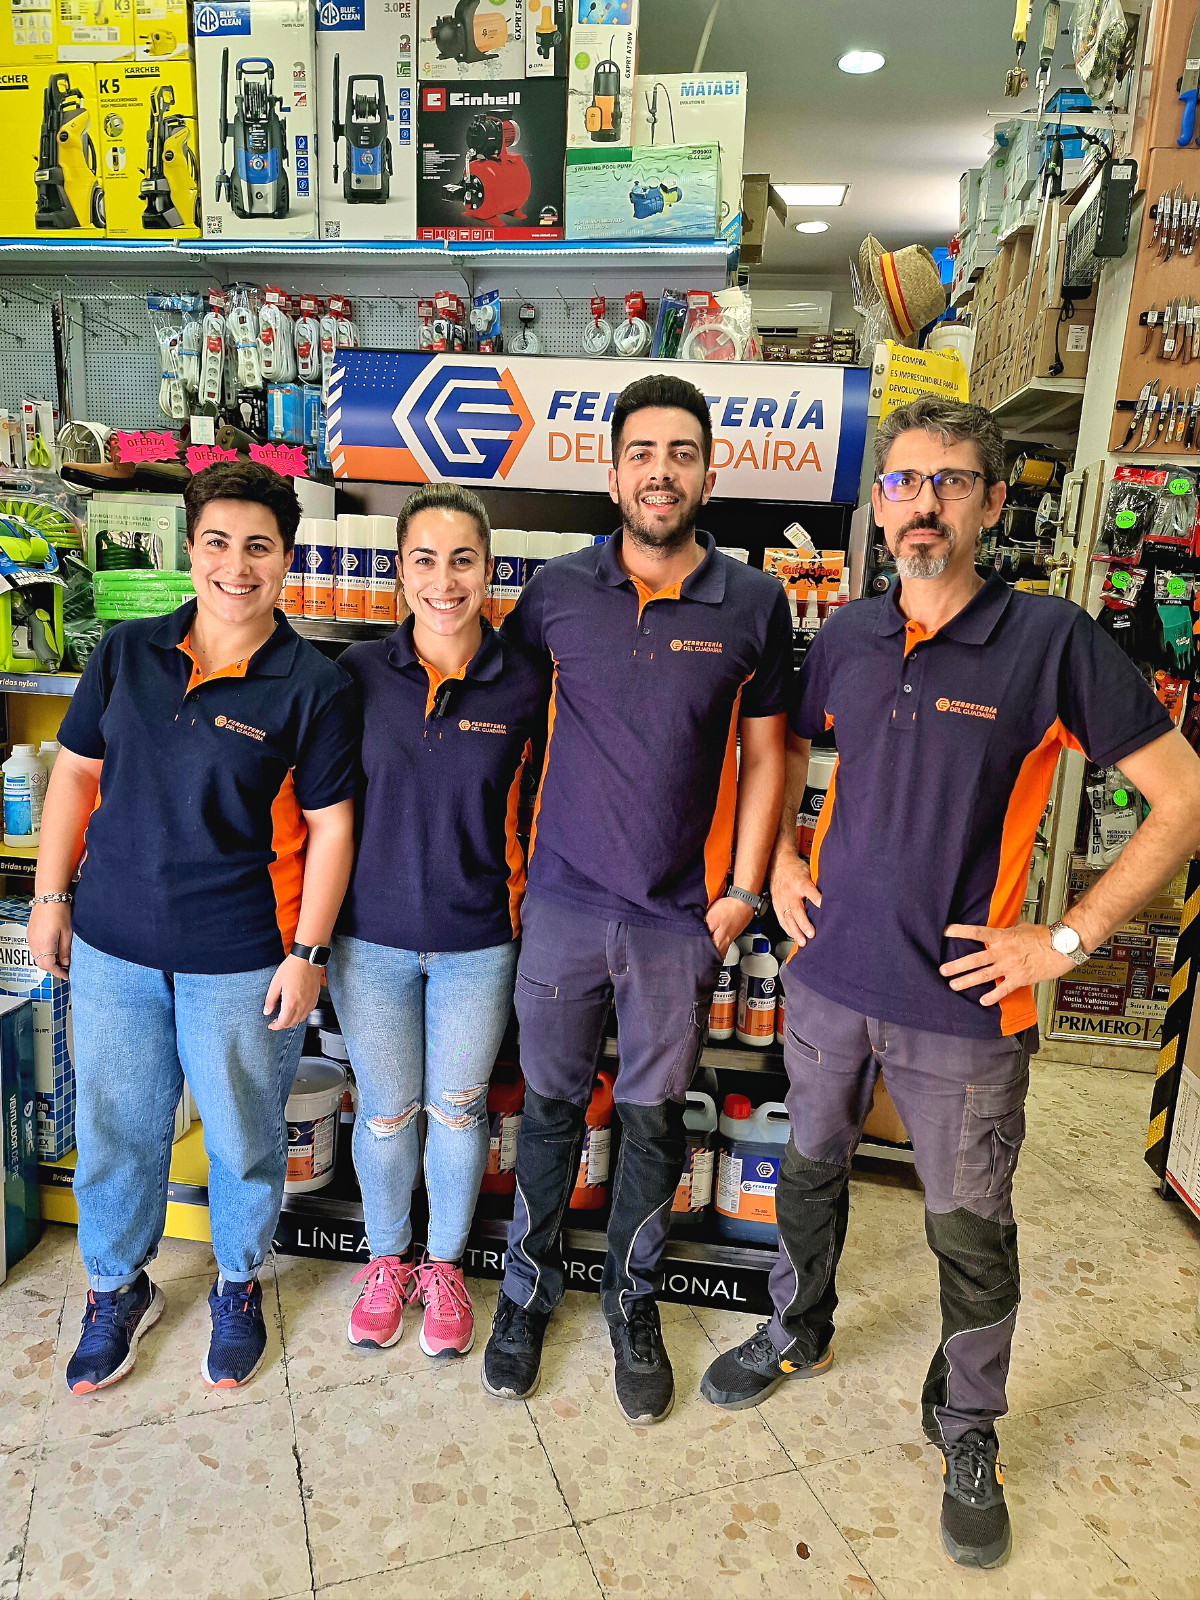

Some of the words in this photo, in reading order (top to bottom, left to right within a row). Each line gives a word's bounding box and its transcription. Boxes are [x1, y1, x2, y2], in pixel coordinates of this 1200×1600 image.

[219, 11, 237, 19] BLUE
[340, 13, 361, 21] CLEAN
[219, 17, 242, 27] CLEAN
[514, 11, 523, 41] GXPRT
[624, 56, 632, 79] GXPRT
[99, 79, 109, 94] K
[112, 78, 120, 94] 5
[680, 80, 740, 97] MATABI
[449, 91, 521, 106] Einhell
[891, 353, 901, 362] DE
[890, 370, 898, 378] ES
[942, 381, 954, 390] PARA
[127, 437, 165, 448] OFERTA
[194, 450, 229, 462] OFERTA
[258, 450, 295, 462] OFERTA
[549, 432, 613, 464] DEL
[709, 431, 823, 473] DAÍRA
[782, 565, 807, 575] Euro
[808, 565, 840, 578] Cyano
[683, 640, 723, 648] FERRETERÍA
[0, 678, 18, 686] ridas
[18, 679, 38, 688] nylon
[949, 706, 962, 714] DEL
[962, 708, 997, 721] GUADAÍRA
[950, 700, 998, 714] FERRETERÍA
[225, 723, 236, 732] DEL
[227, 719, 267, 737] FERRETERÍA
[471, 721, 507, 730] FERRETERÍA
[1092, 789, 1102, 855] SAFETOP
[0, 862, 22, 871] Bridas
[22, 864, 37, 873] nylo
[1071, 967, 1117, 977] ARQUITECTO
[1062, 995, 1082, 1003] Noelia
[1058, 1014, 1141, 1036] PRIMERO
[9, 1093, 20, 1153] VENTILADOR
[297, 1226, 370, 1253] LÍNEA
